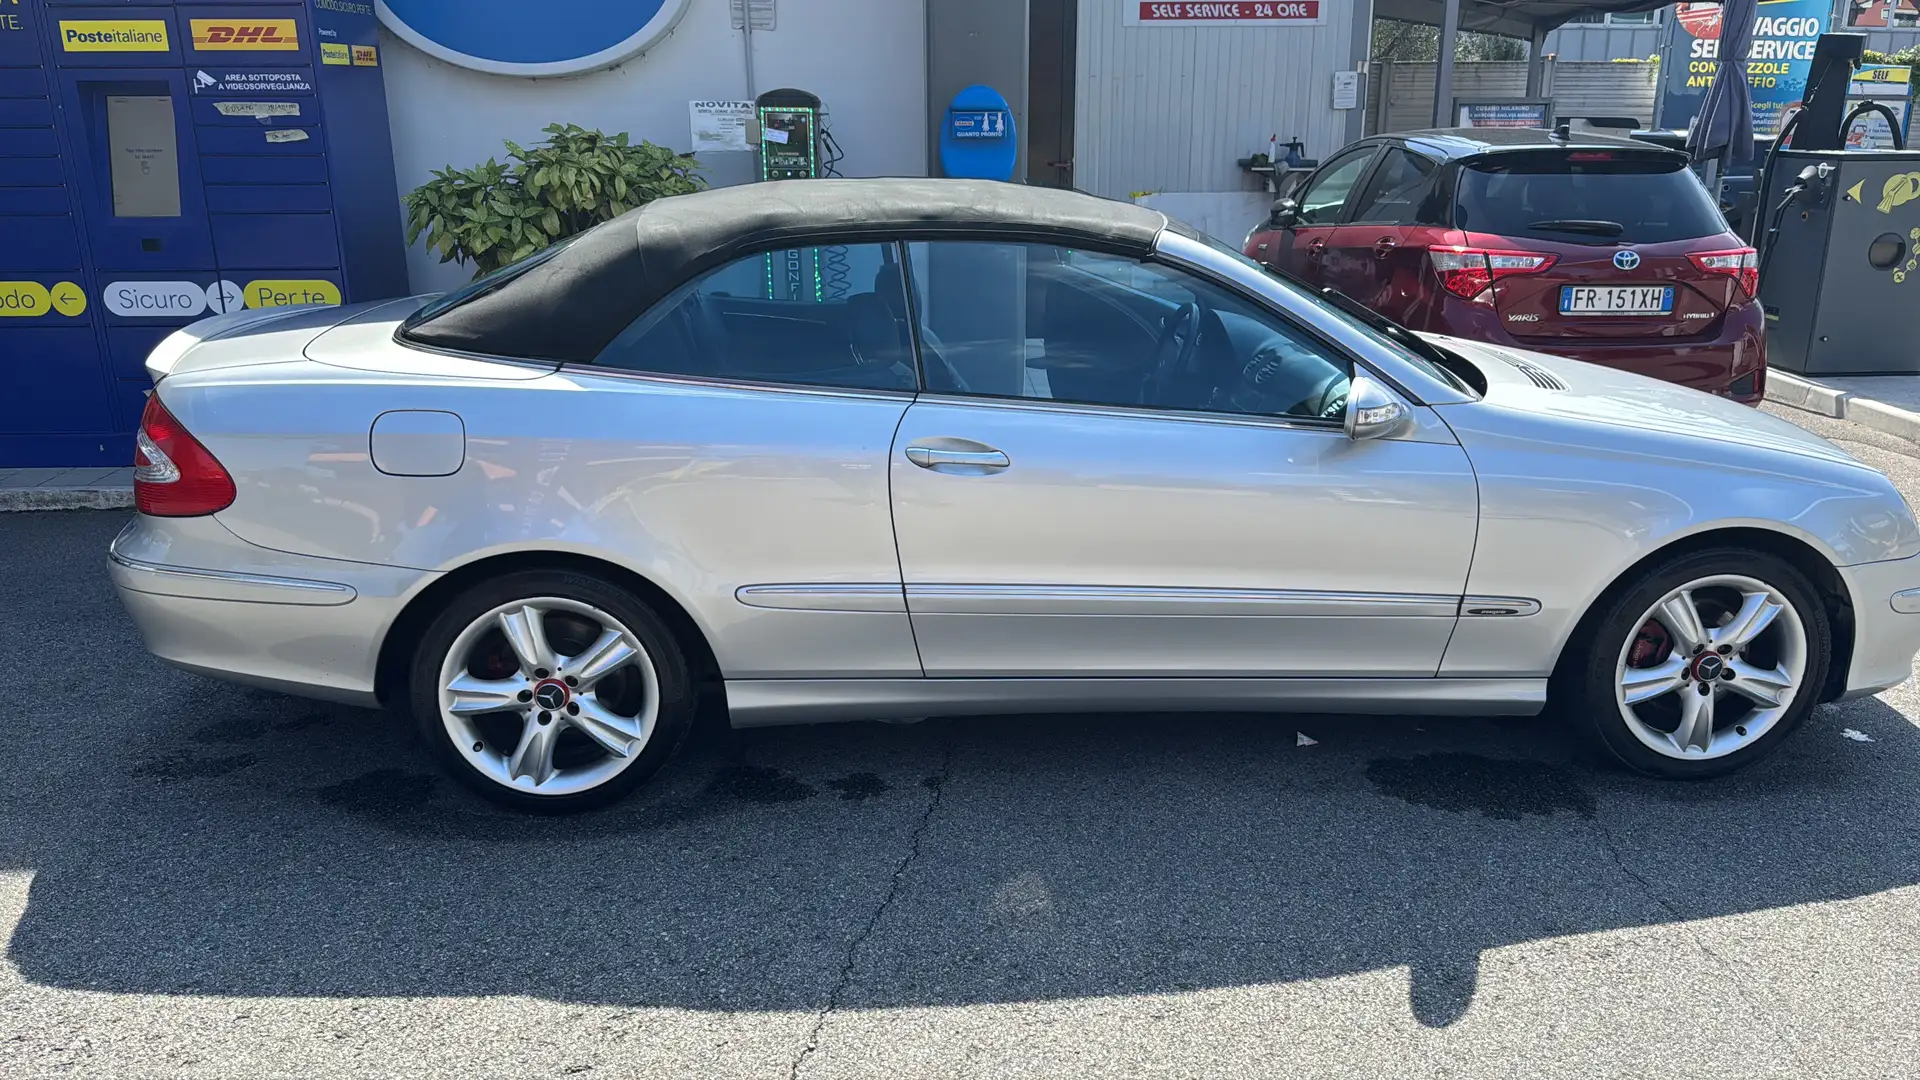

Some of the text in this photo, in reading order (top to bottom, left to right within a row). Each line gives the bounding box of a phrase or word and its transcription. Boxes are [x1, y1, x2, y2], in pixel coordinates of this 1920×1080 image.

[1151, 4, 1182, 17] SELF
[1185, 4, 1240, 17] SERVICE
[1254, 4, 1273, 17] 24
[1277, 3, 1308, 17] ORE
[207, 26, 284, 43] DHL
[1752, 16, 1819, 36] VAGGIO
[66, 29, 163, 43] Posteitaliane
[1690, 38, 1817, 59] SEL ERVICE
[1747, 62, 1790, 74] ZZOLE
[1872, 70, 1889, 80] SELF
[118, 288, 193, 309] Sicuro
[258, 287, 326, 307] Per te
[1573, 289, 1597, 309] FR
[1508, 313, 1540, 322] YARIS
